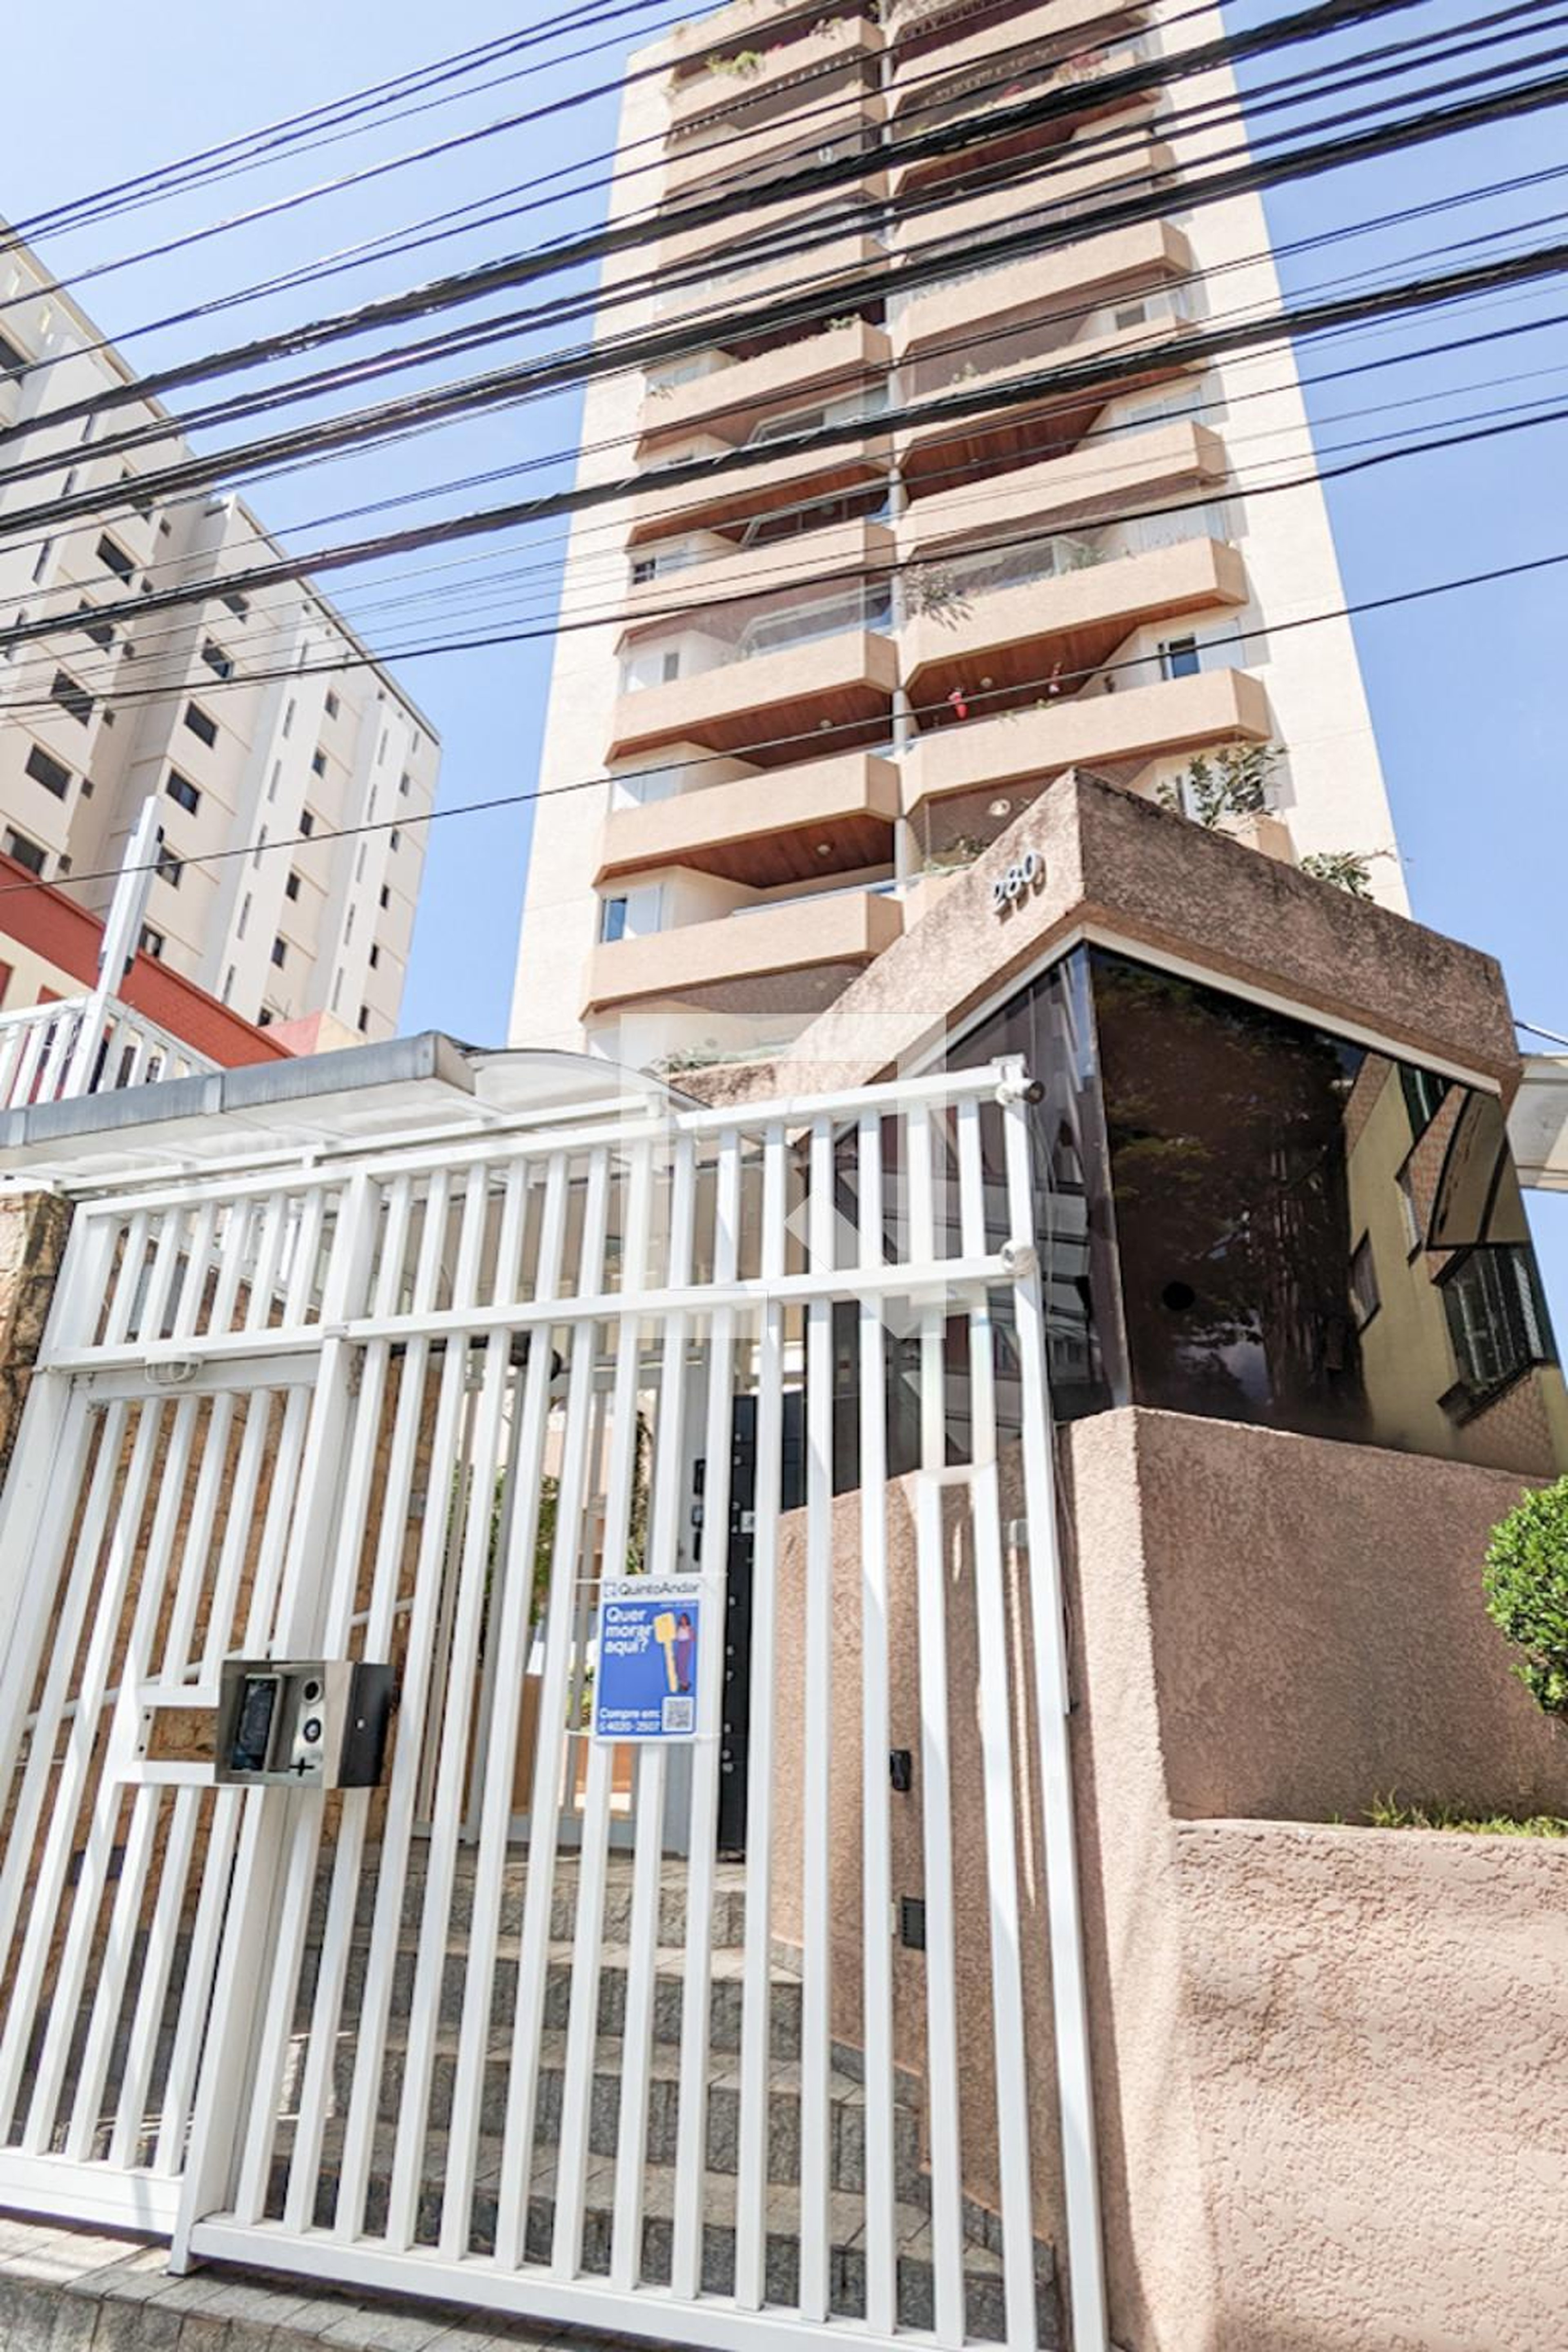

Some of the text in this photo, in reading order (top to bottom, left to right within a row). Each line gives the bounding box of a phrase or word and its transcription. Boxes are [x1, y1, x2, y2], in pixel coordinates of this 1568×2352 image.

[993, 851, 1040, 913] 280
[619, 1581, 700, 1596] QuintoAndar
[606, 1606, 647, 1622] Quer
[605, 1624, 653, 1637] morar
